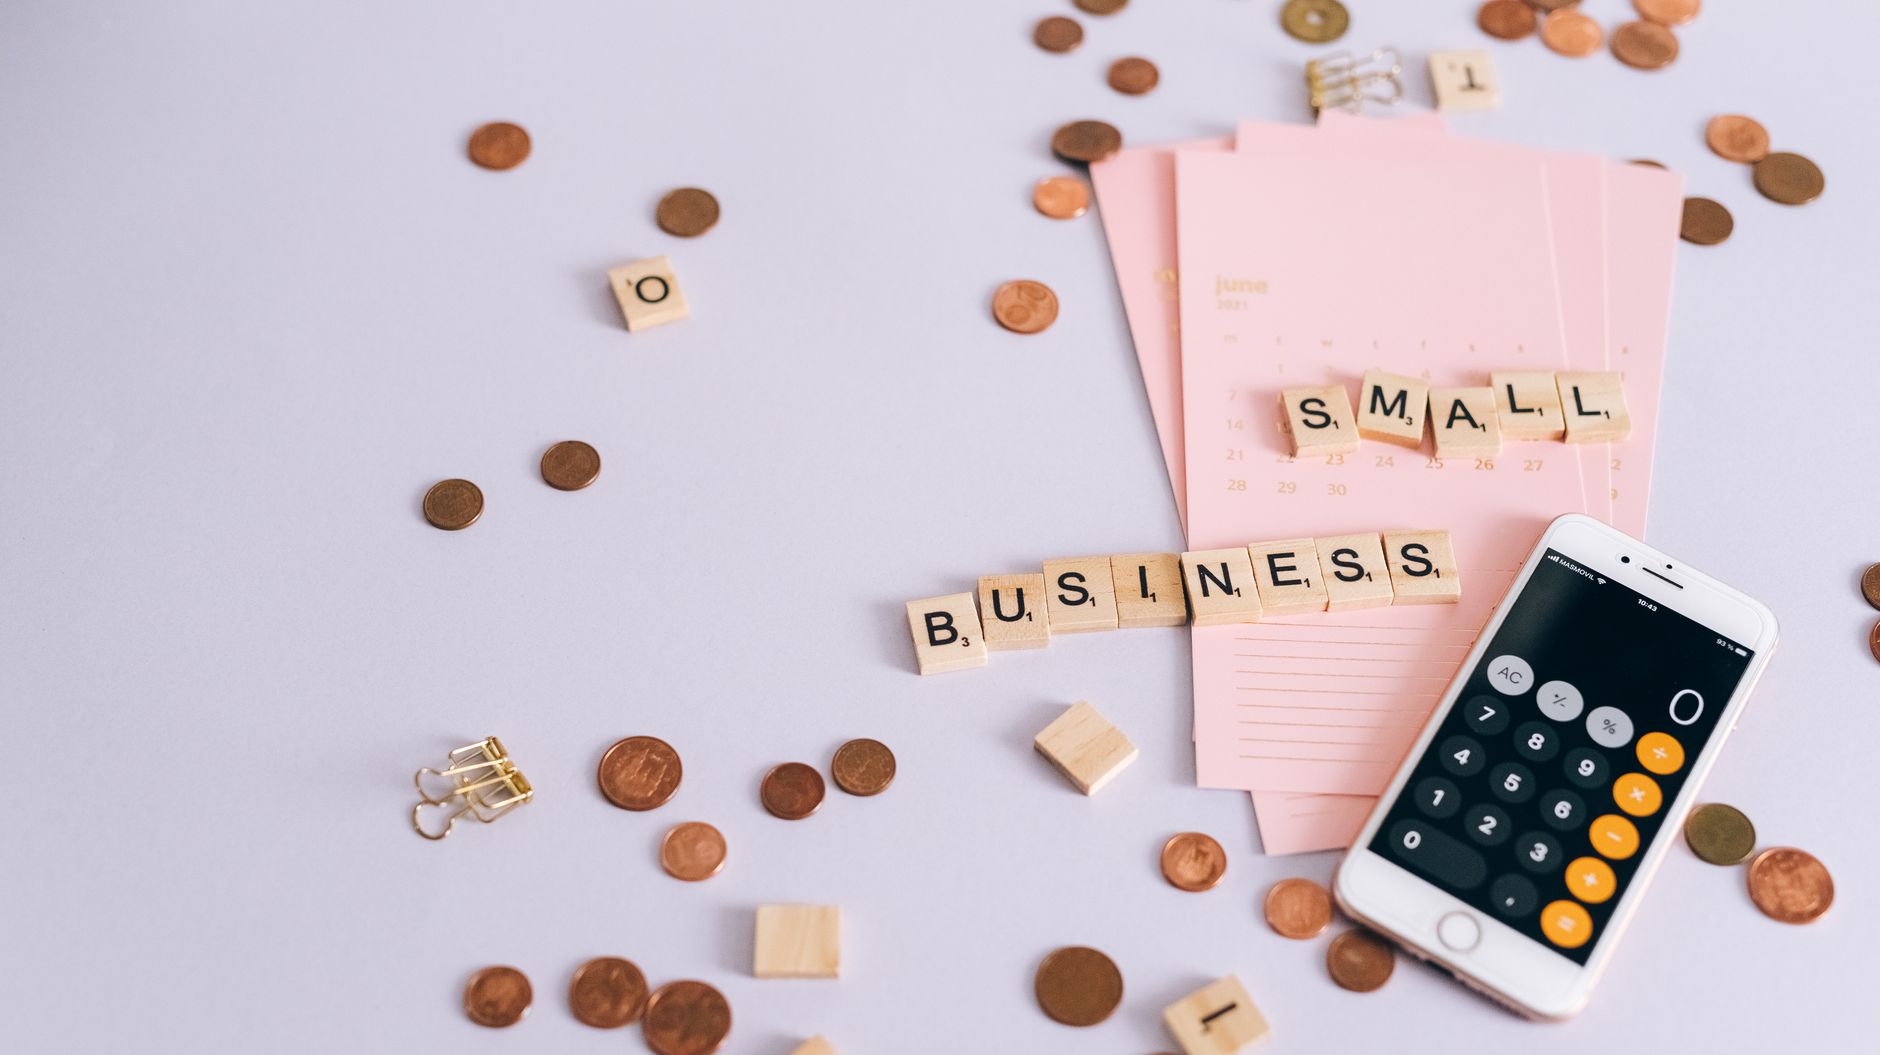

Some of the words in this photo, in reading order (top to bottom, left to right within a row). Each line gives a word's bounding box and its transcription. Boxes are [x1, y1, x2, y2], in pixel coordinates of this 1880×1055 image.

[635, 276, 669, 303] O
[1215, 274, 1268, 296] june
[1299, 384, 1602, 430] SMALL
[1226, 449, 1244, 461] 21
[1325, 454, 1345, 466] 23
[1375, 455, 1394, 468] 24
[1425, 457, 1444, 470] 25
[1474, 459, 1494, 471] 26
[1523, 460, 1544, 472] 27
[1227, 479, 1247, 492] 28
[1277, 481, 1297, 494] 29
[1327, 483, 1347, 496] 30
[1558, 558, 1595, 581] MASMOVIL
[924, 543, 1433, 647] BUSINESS
[1637, 598, 1658, 612] 10:43
[1716, 638, 1727, 648] 93
[1497, 666, 1523, 684] AC
[1478, 705, 1497, 722] 7
[1668, 689, 1705, 726] 0
[1527, 733, 1546, 751] 8
[1453, 749, 1471, 766] 4
[1577, 758, 1596, 777] 9
[1503, 772, 1523, 792] 5
[1432, 789, 1445, 807] 1
[1554, 800, 1573, 820] 6
[1477, 815, 1498, 836] 2
[1403, 830, 1422, 850] 0
[1529, 842, 1549, 863] 3
